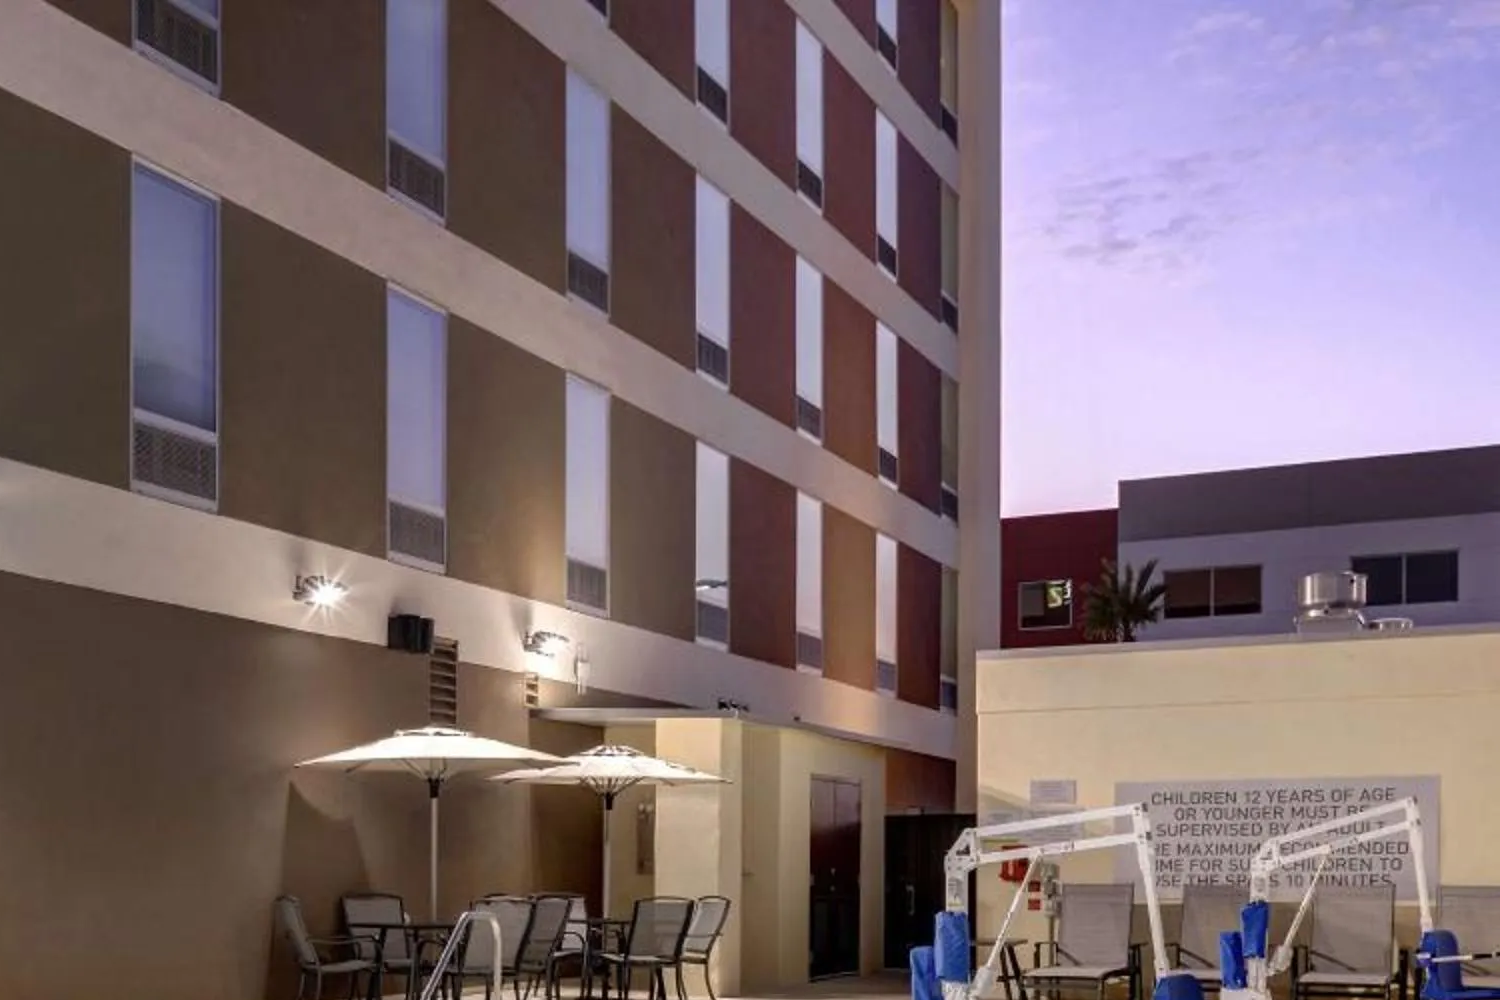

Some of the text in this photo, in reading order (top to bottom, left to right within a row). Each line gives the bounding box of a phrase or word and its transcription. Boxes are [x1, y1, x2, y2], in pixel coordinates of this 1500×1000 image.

[1151, 786, 1397, 806] CHILDREN 12 YEARS OF AGE
[1173, 806, 1197, 821] OR
[1200, 805, 1285, 821] YOUNGER
[1291, 804, 1341, 820] MUST
[1155, 822, 1263, 837] SUPERVISED
[1269, 821, 1290, 837] BY
[1155, 842, 1172, 857] HE
[1177, 842, 1261, 857] MAXIMUM
[1155, 858, 1184, 873] IME
[1189, 858, 1223, 872] FOR
[1380, 857, 1404, 871] TO
[1188, 872, 1222, 887] THE
[1286, 873, 1304, 888] 10
